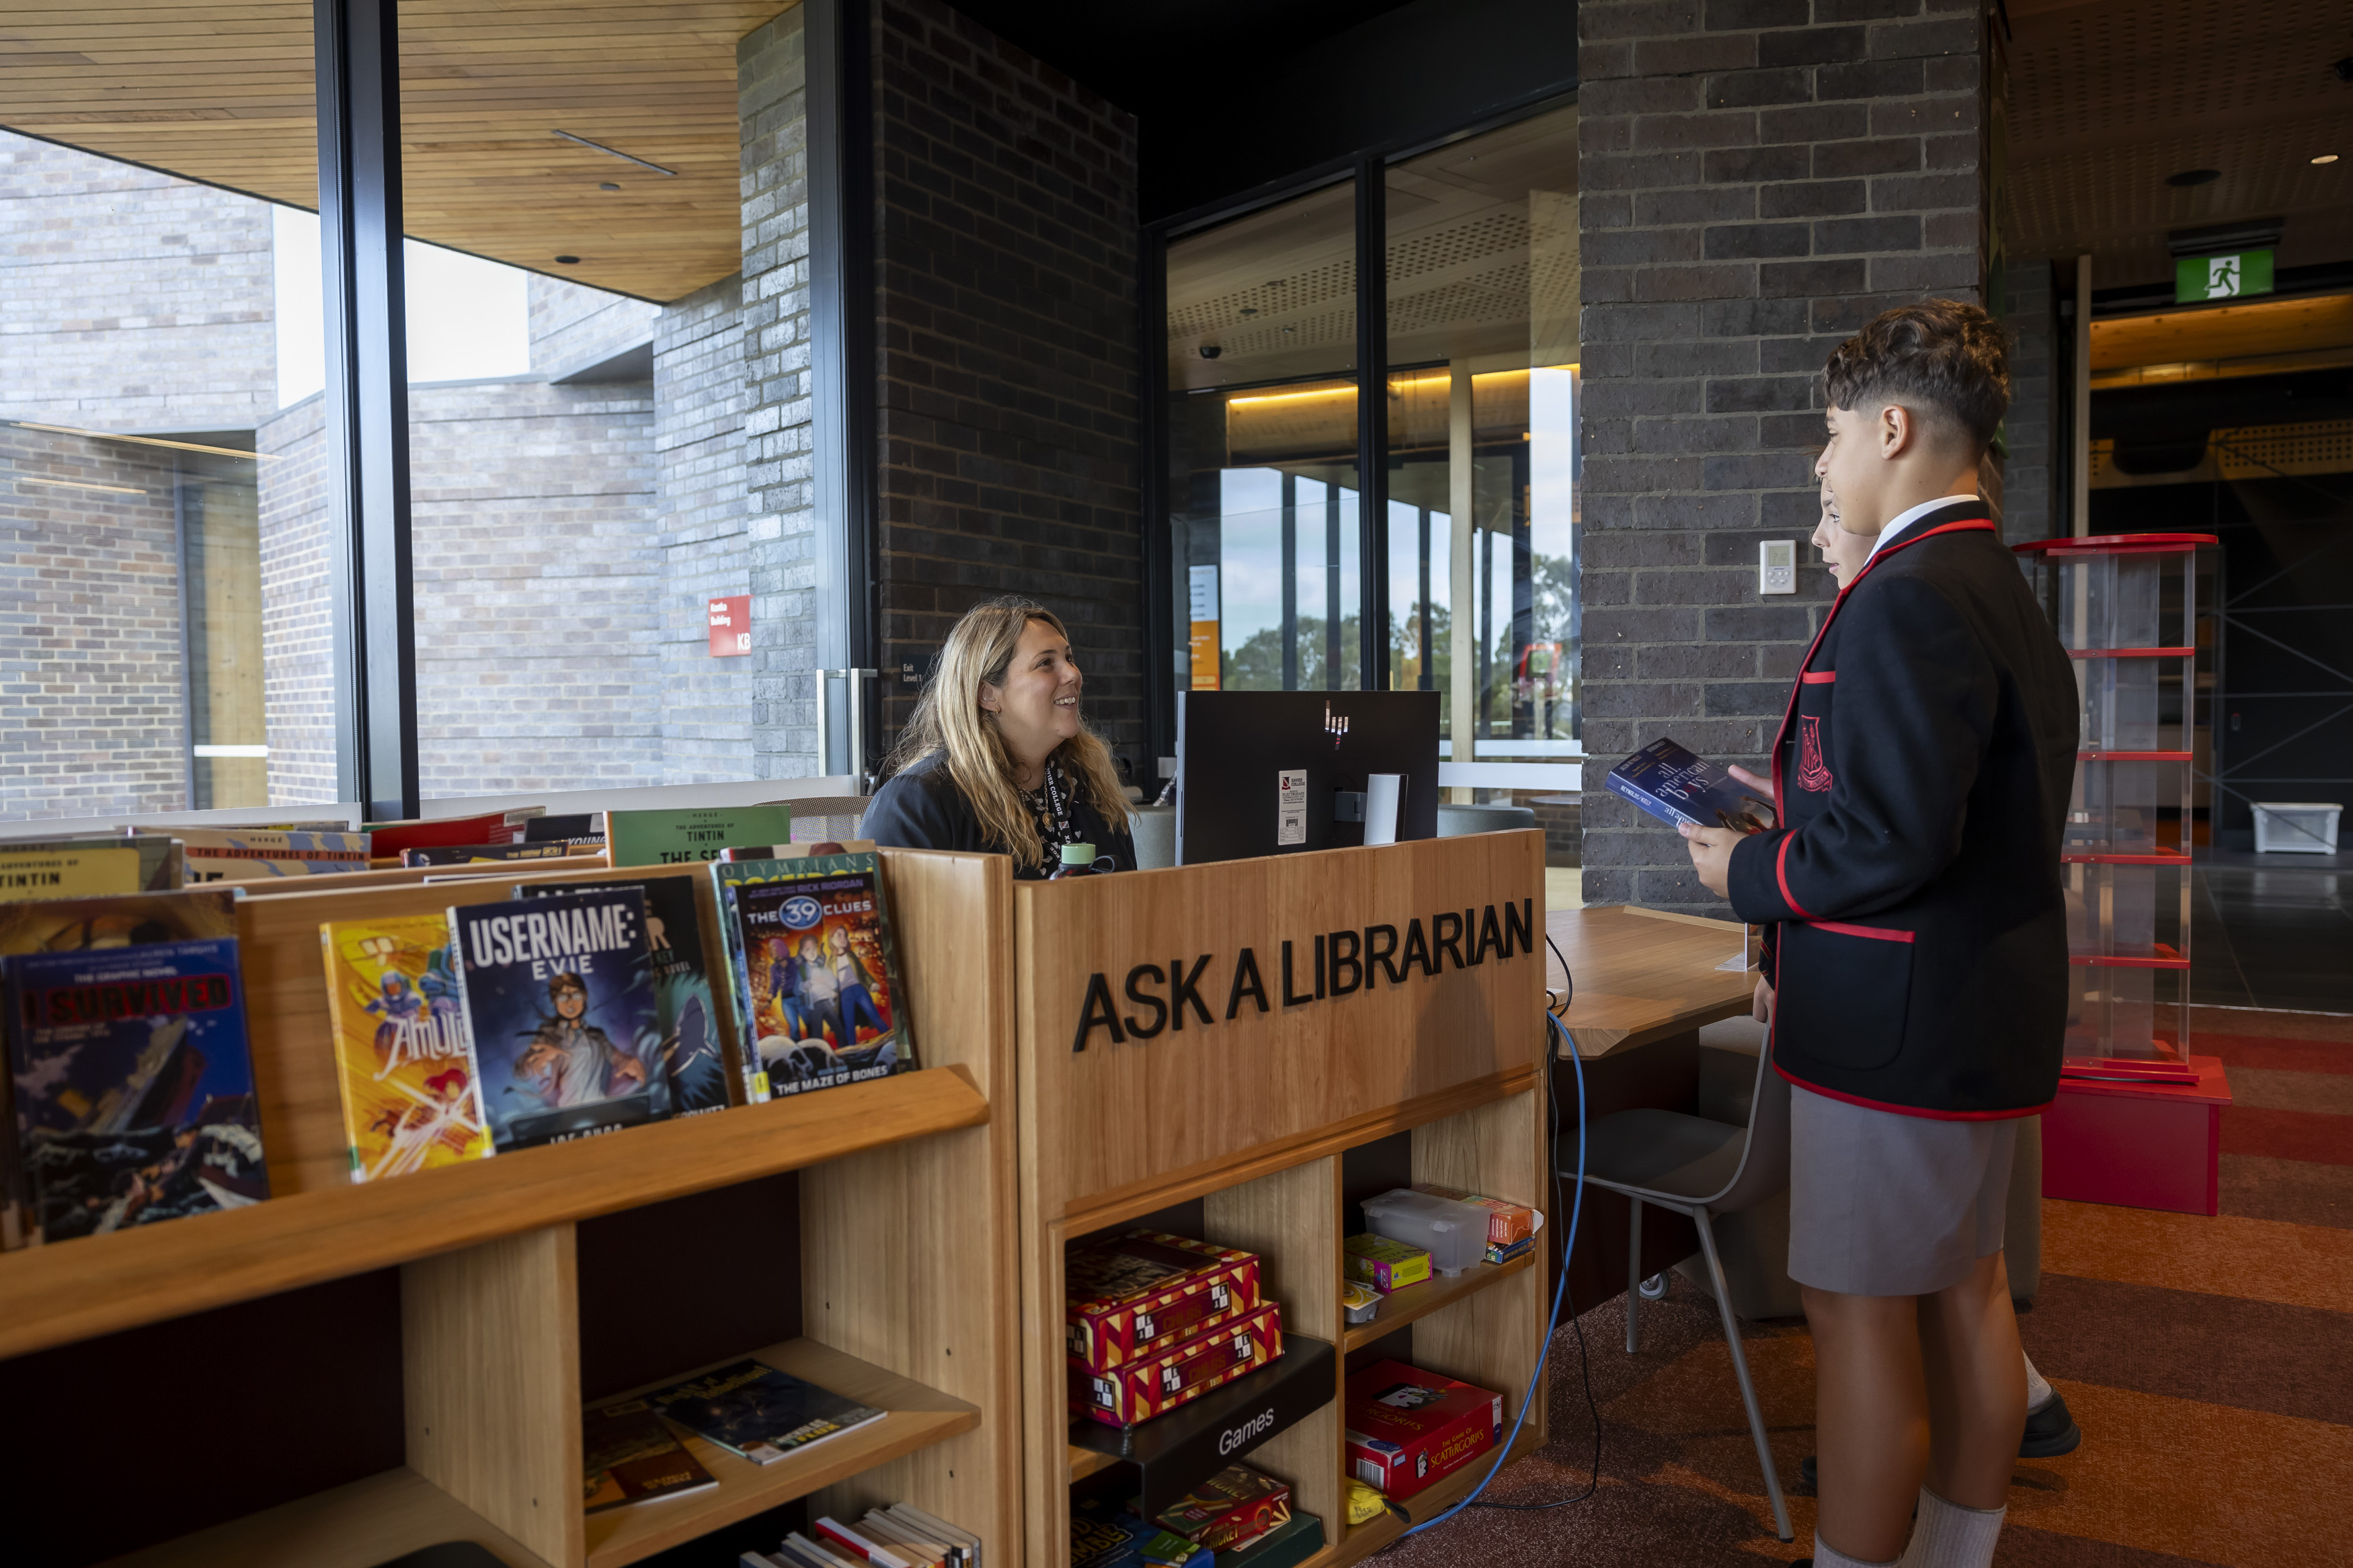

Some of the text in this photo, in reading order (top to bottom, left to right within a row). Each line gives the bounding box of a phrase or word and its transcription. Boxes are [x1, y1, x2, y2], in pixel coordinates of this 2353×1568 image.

[737, 632, 751, 651] KB
[904, 663, 914, 672] Exit
[904, 673, 922, 682] Level 1
[1655, 761, 1710, 797] american
[1658, 762, 1678, 779] all
[1665, 774, 1710, 800] boys
[1050, 786, 1064, 817] COLLEGE
[1664, 807, 1675, 817] all
[687, 830, 725, 841] TINTIN
[198, 848, 365, 860] THE ADVENTURES OF TINTIN
[722, 853, 874, 878] OLYMPIANS
[797, 884, 820, 893] RICK
[821, 878, 863, 891] RIORDAN
[747, 900, 871, 925] THE 39 CLUES
[469, 903, 637, 968] USERNAME:
[532, 954, 594, 981] EVIE
[1074, 898, 1533, 1053] ASK A LIBRARIAN
[48, 975, 231, 1024] SURVIVED
[776, 1065, 889, 1096] THE MAZE OF BONES
[1219, 1407, 1274, 1456] Games
[1452, 1432, 1465, 1443] GAME
[1431, 1429, 1484, 1468] SCATTERGORIES
